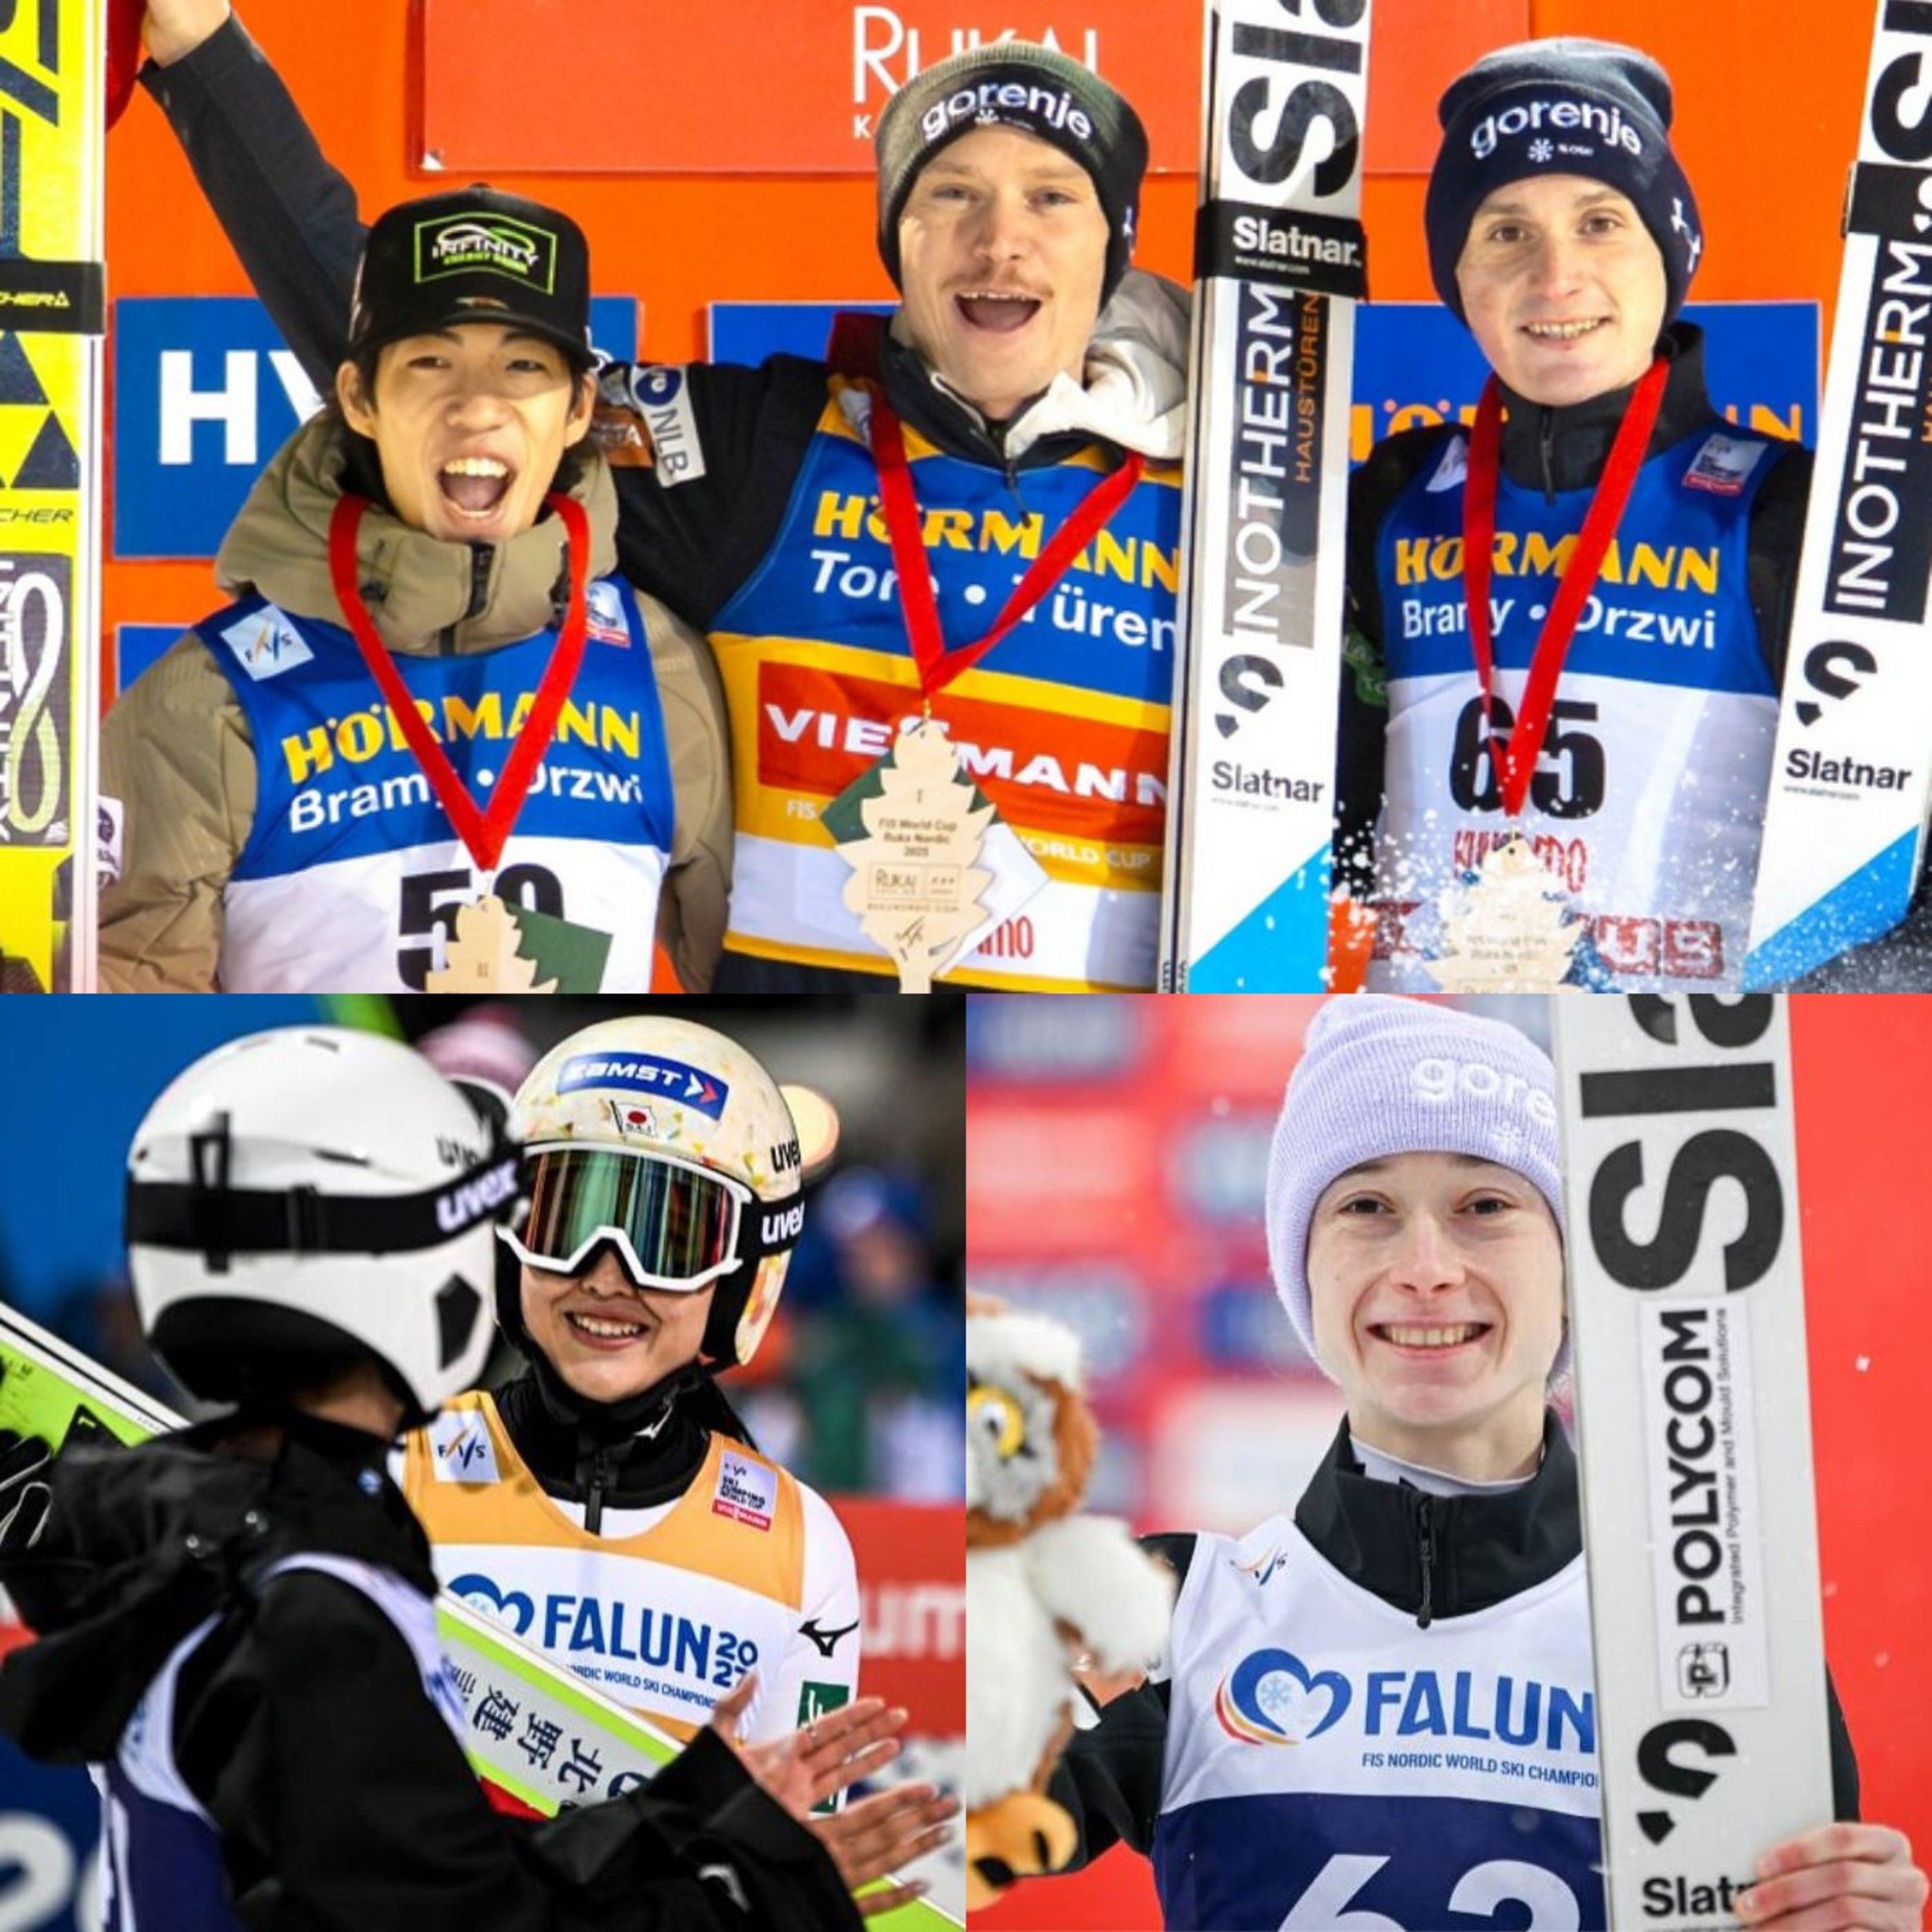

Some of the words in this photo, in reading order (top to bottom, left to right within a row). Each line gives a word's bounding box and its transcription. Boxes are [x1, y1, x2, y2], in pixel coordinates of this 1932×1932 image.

[922, 82, 1091, 140] gorenje
[1471, 101, 1641, 159] gorenje
[431, 236, 540, 266] INFINITY
[1233, 216, 1358, 266] Slatnar
[650, 409, 690, 475] NLB
[1835, 241, 1932, 609] INOTHERM
[1231, 282, 1295, 645] INOTHERM
[813, 491, 1179, 594] HÖRMNN
[1013, 574, 1176, 650] üren
[764, 704, 1167, 807] VIEMANN
[1212, 761, 1324, 802] Slatnar
[1450, 695, 1605, 820] 65
[1785, 748, 1911, 791] Slatnar
[290, 772, 457, 833] Bram
[901, 819, 932, 831] World
[935, 820, 958, 833] Cup
[1021, 838, 1099, 865] ORLD
[1104, 853, 1151, 870] CUP
[770, 1140, 801, 1173] uve
[436, 1160, 518, 1233] uvex
[762, 1200, 805, 1244] uve
[1716, 1308, 1730, 1381] Solutions
[1719, 1386, 1734, 1435] Mould
[1660, 1309, 1726, 1626] POLYCOM
[1722, 1439, 1736, 1470] and
[1725, 1474, 1741, 1539] Polymer
[544, 1594, 711, 1680] FALUN
[715, 1631, 758, 1666] 20
[604, 1668, 641, 1689] WORLD
[643, 1679, 659, 1695] SKI
[1365, 1671, 1595, 1754] FALUN
[1362, 1752, 1385, 1767] FIS
[1388, 1752, 1442, 1768] NORDIC
[1446, 1755, 1497, 1773] WORLD
[1501, 1761, 1524, 1777] SKI
[1528, 1766, 1598, 1788] CHAMPIO
[1642, 1877, 1757, 1917] Slat
